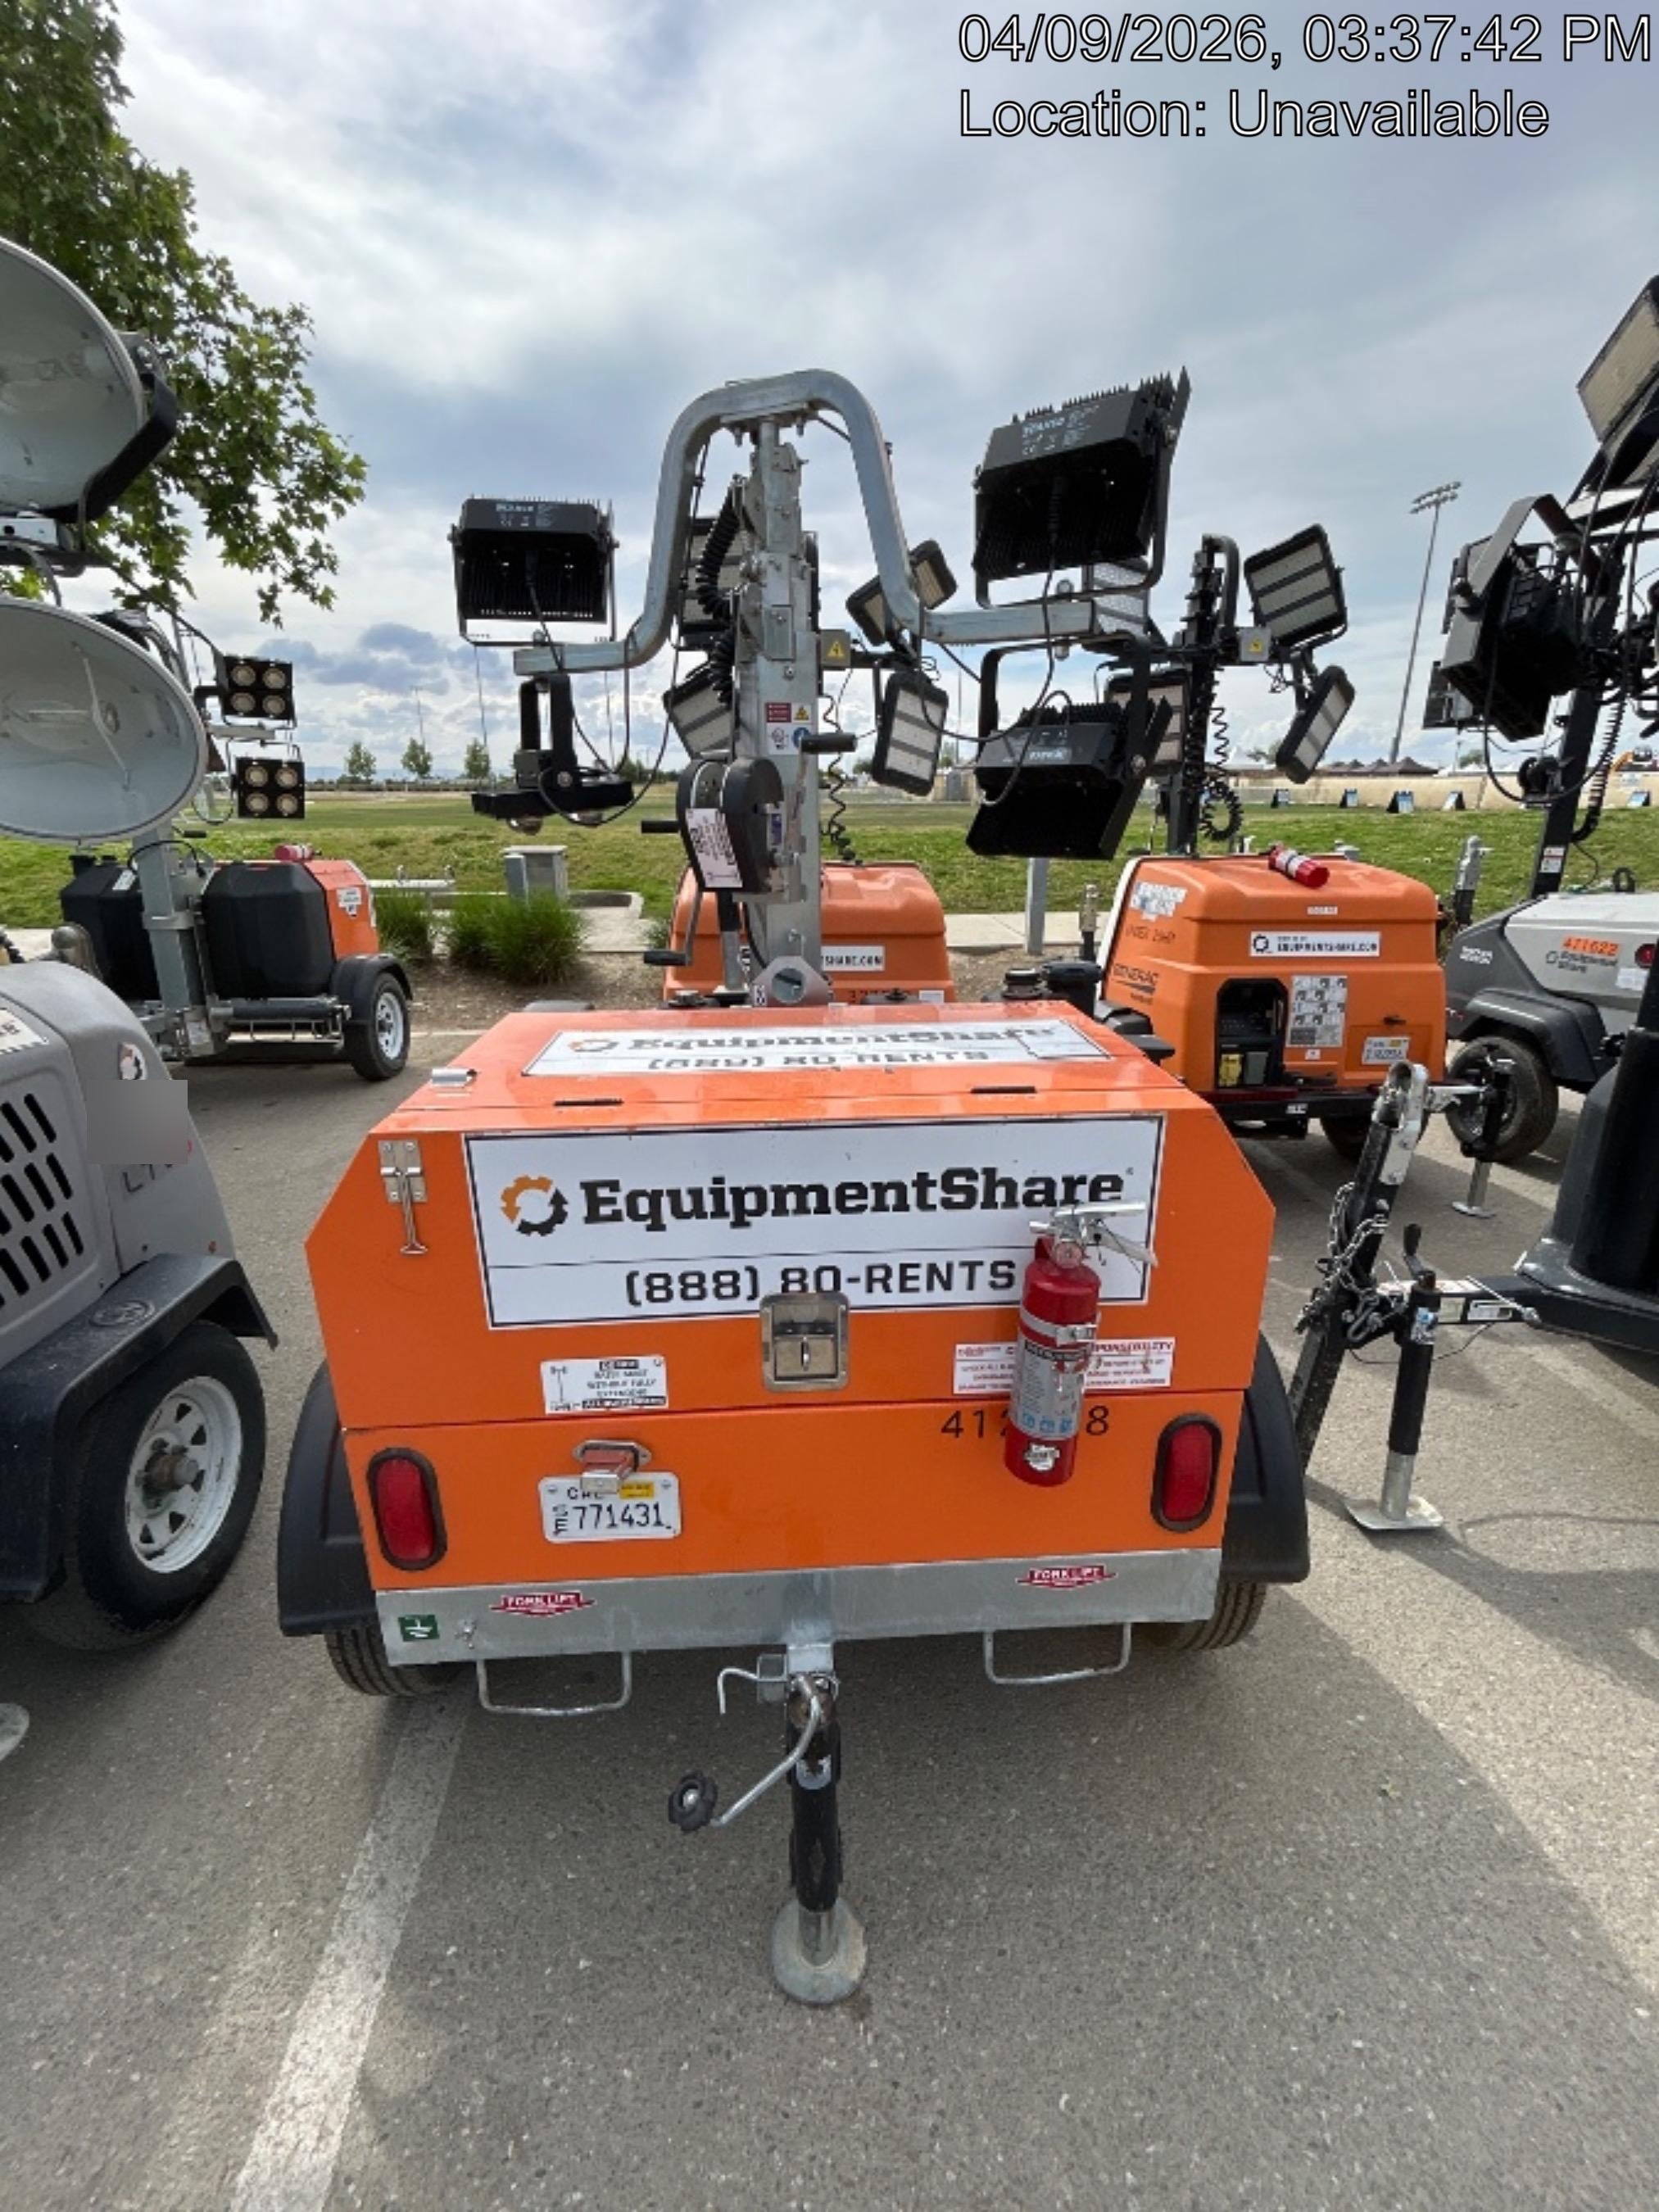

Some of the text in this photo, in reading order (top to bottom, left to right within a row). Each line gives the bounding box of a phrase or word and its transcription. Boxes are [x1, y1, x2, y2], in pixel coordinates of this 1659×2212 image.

[628, 1028, 1054, 1051] EquipmentShare
[581, 1167, 1122, 1232] EquipmentShare
[624, 1260, 1015, 1306] (888) 80-RENTS
[941, 1406, 1108, 1439] 418
[573, 1502, 664, 1530] 771431
